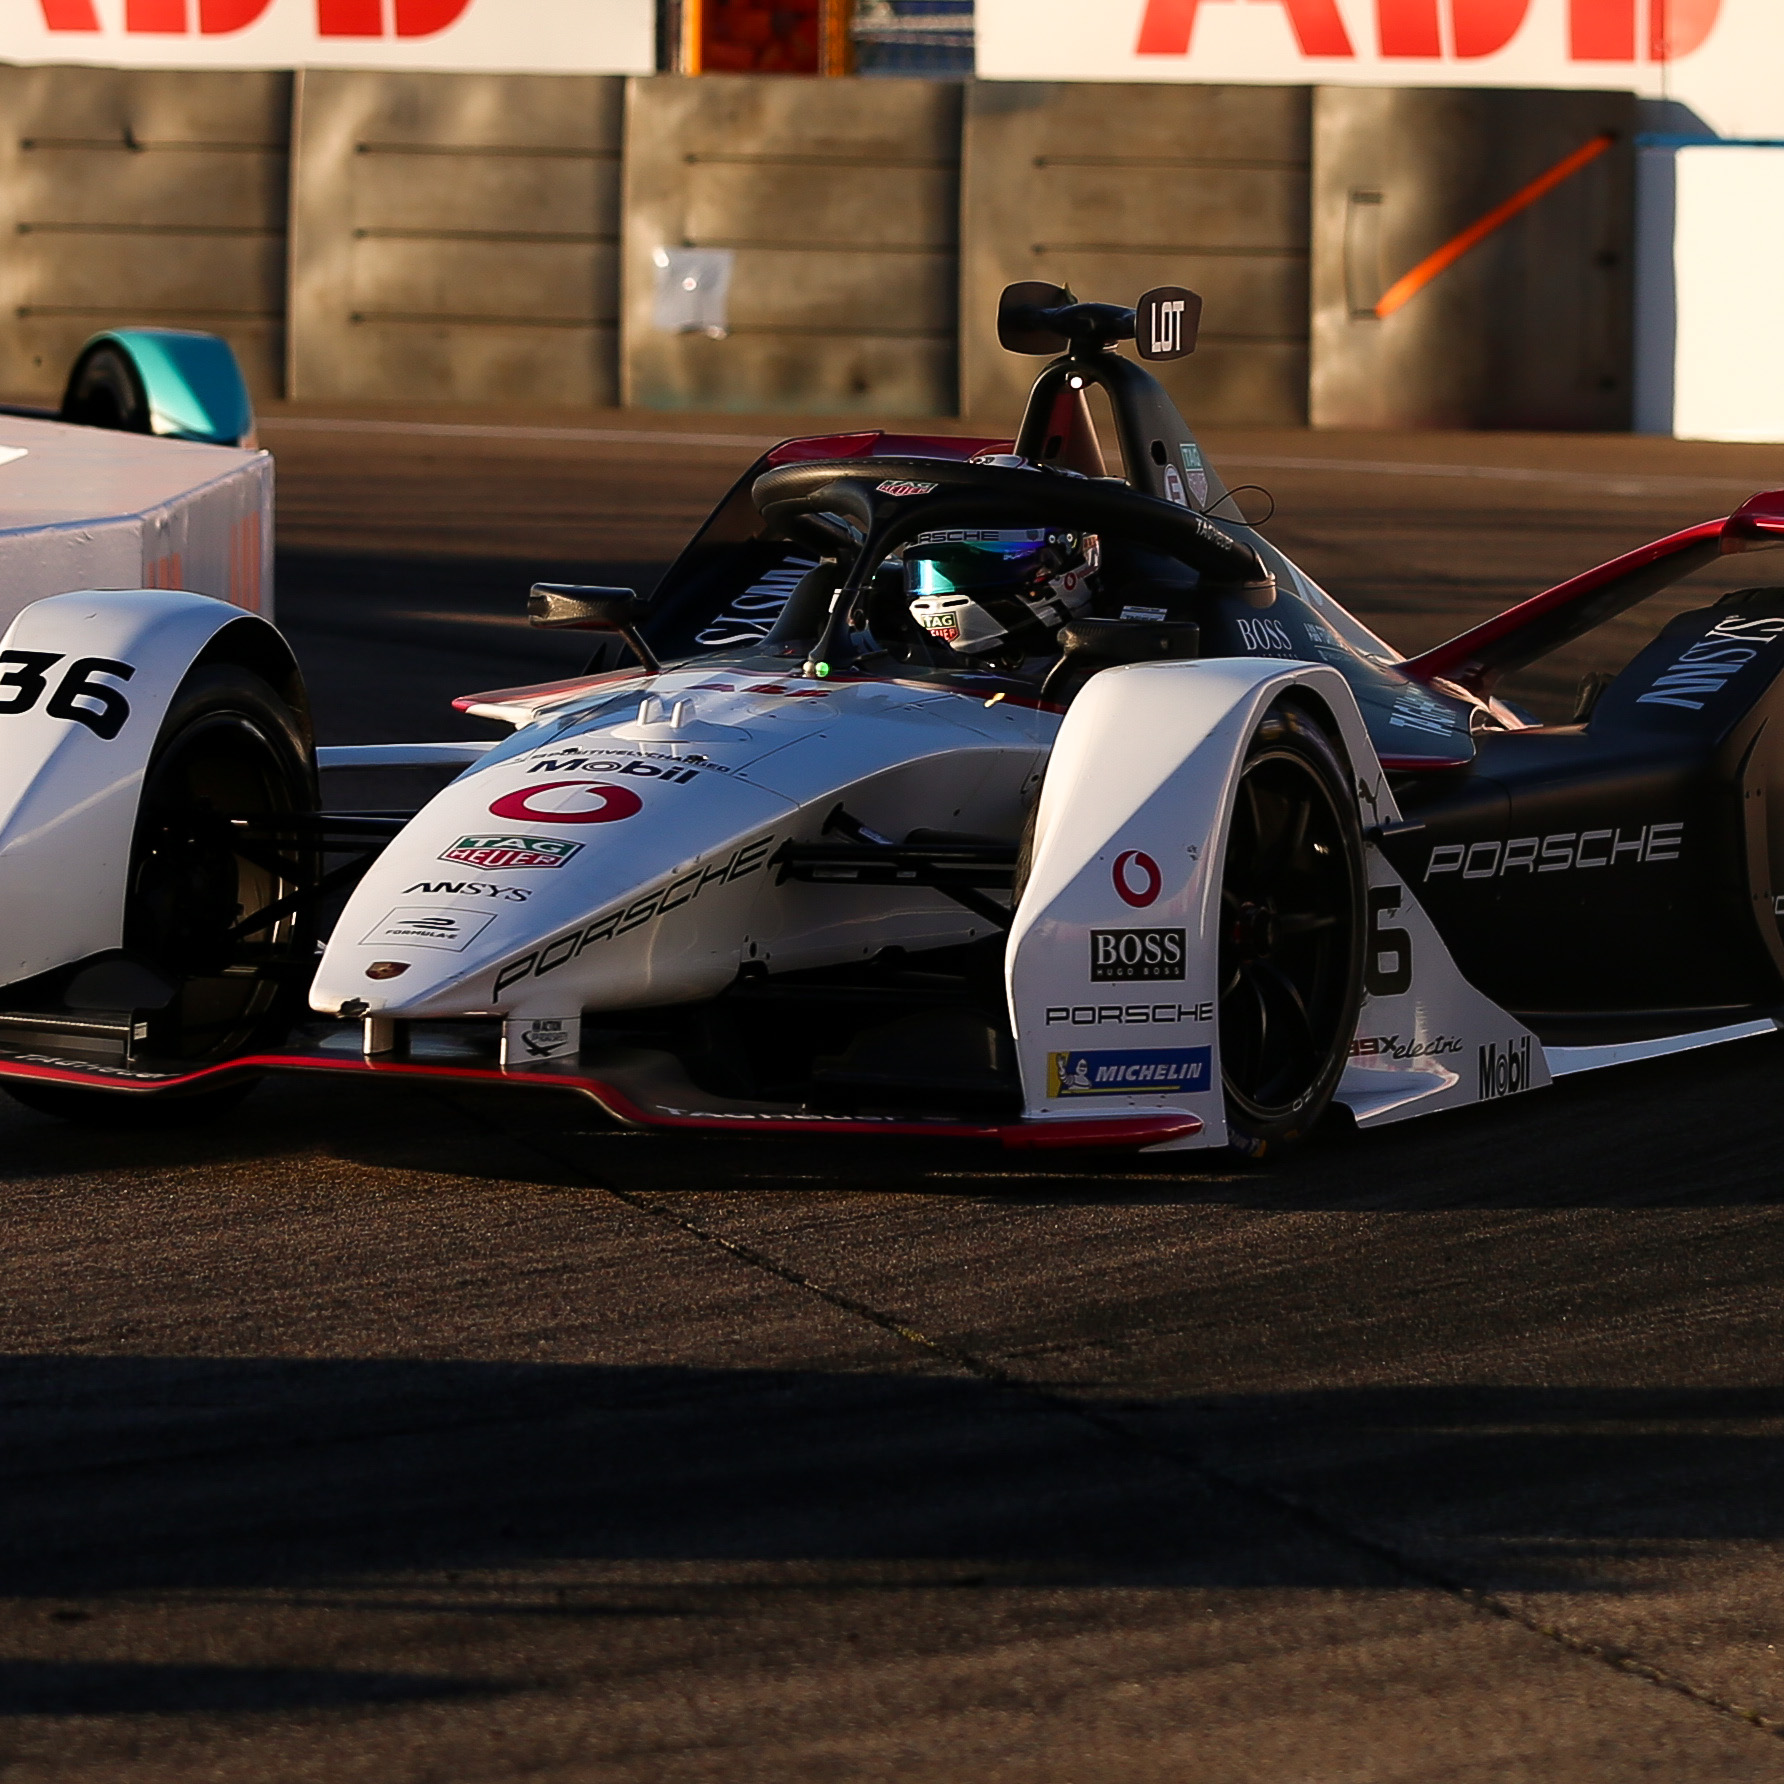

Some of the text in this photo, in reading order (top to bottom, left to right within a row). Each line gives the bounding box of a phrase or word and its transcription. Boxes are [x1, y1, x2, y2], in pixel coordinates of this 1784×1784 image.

[1151, 300, 1185, 353] LOT
[923, 613, 955, 628] TAG
[1236, 618, 1293, 651] BOSS
[526, 757, 701, 785] Mobil
[468, 836, 567, 854] TAG
[1423, 822, 1684, 883] PORSCHE
[450, 849, 559, 868] HEUER
[401, 881, 533, 903] ANSYS
[491, 836, 776, 1004] PORSCHE
[1096, 933, 1182, 965] BOSS
[1096, 967, 1181, 976] HUGO BOSS
[1045, 1002, 1214, 1025] PORSCHE
[1393, 1035, 1463, 1060] electric
[1094, 1062, 1203, 1083] MICHELIN
[1478, 1036, 1531, 1100] Mobil
